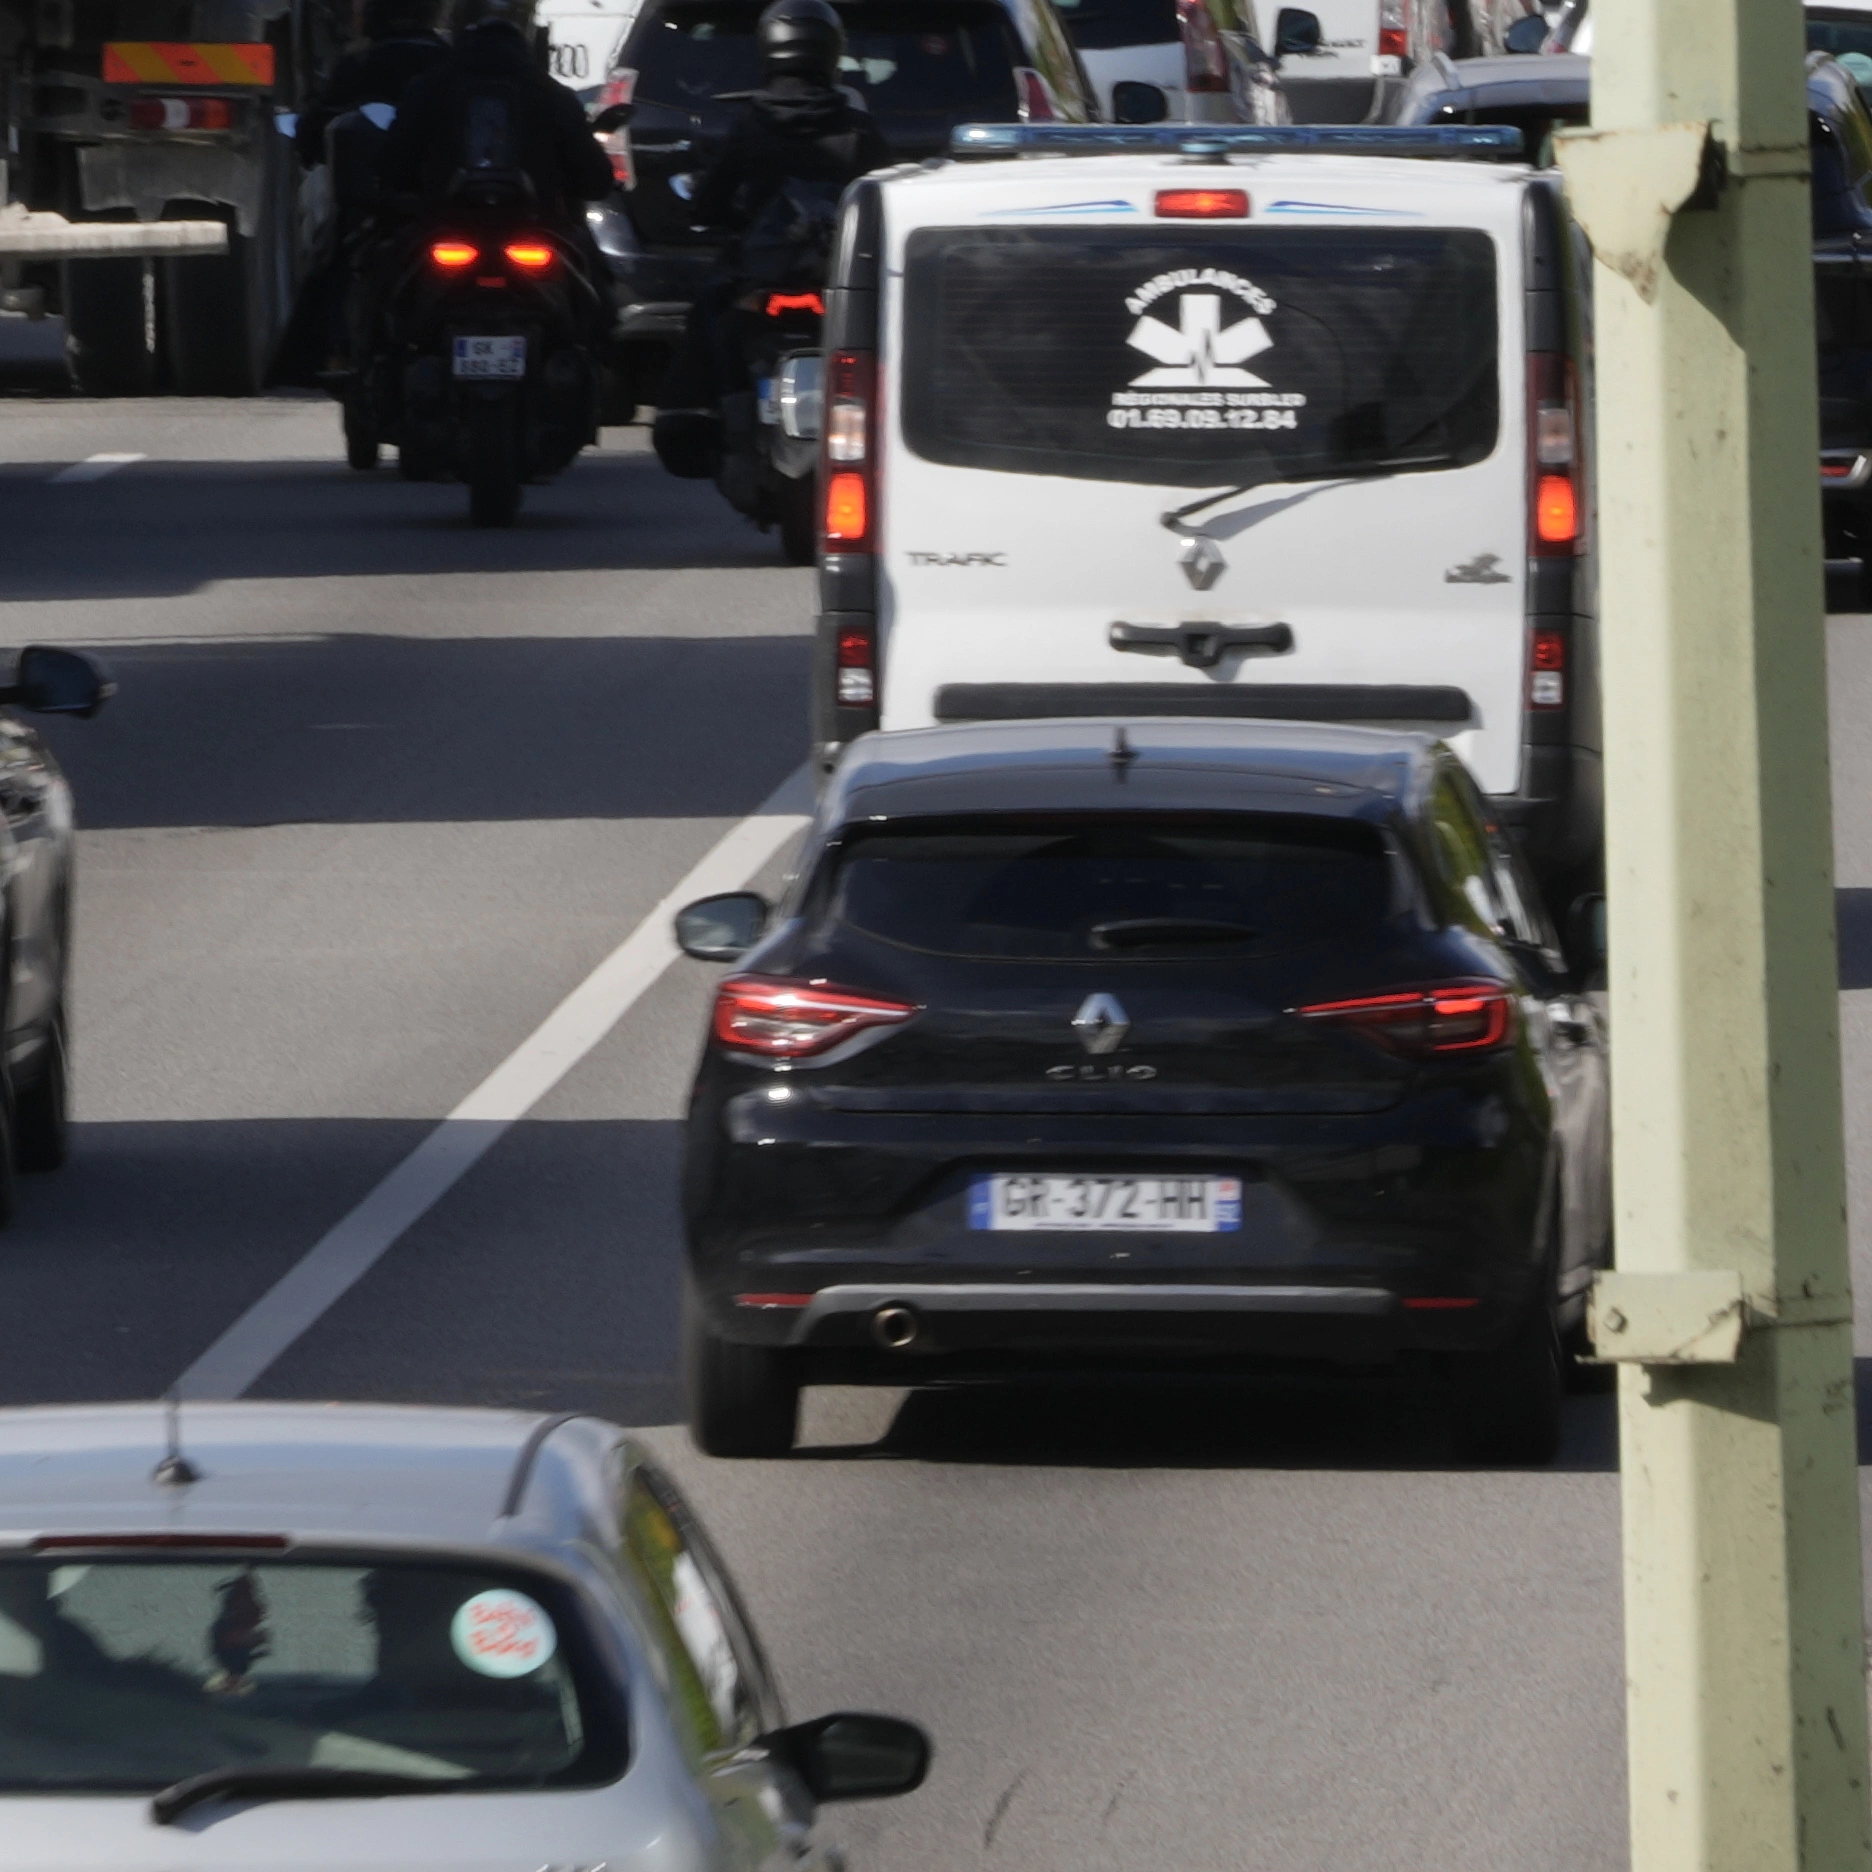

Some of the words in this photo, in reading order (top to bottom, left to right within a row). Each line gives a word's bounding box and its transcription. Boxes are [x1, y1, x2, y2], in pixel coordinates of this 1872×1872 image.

[1125, 268, 1277, 315] AMBULANCES
[1045, 1065, 1157, 1080] CLIO
[1002, 1178, 1207, 1219] GR-372-HH
